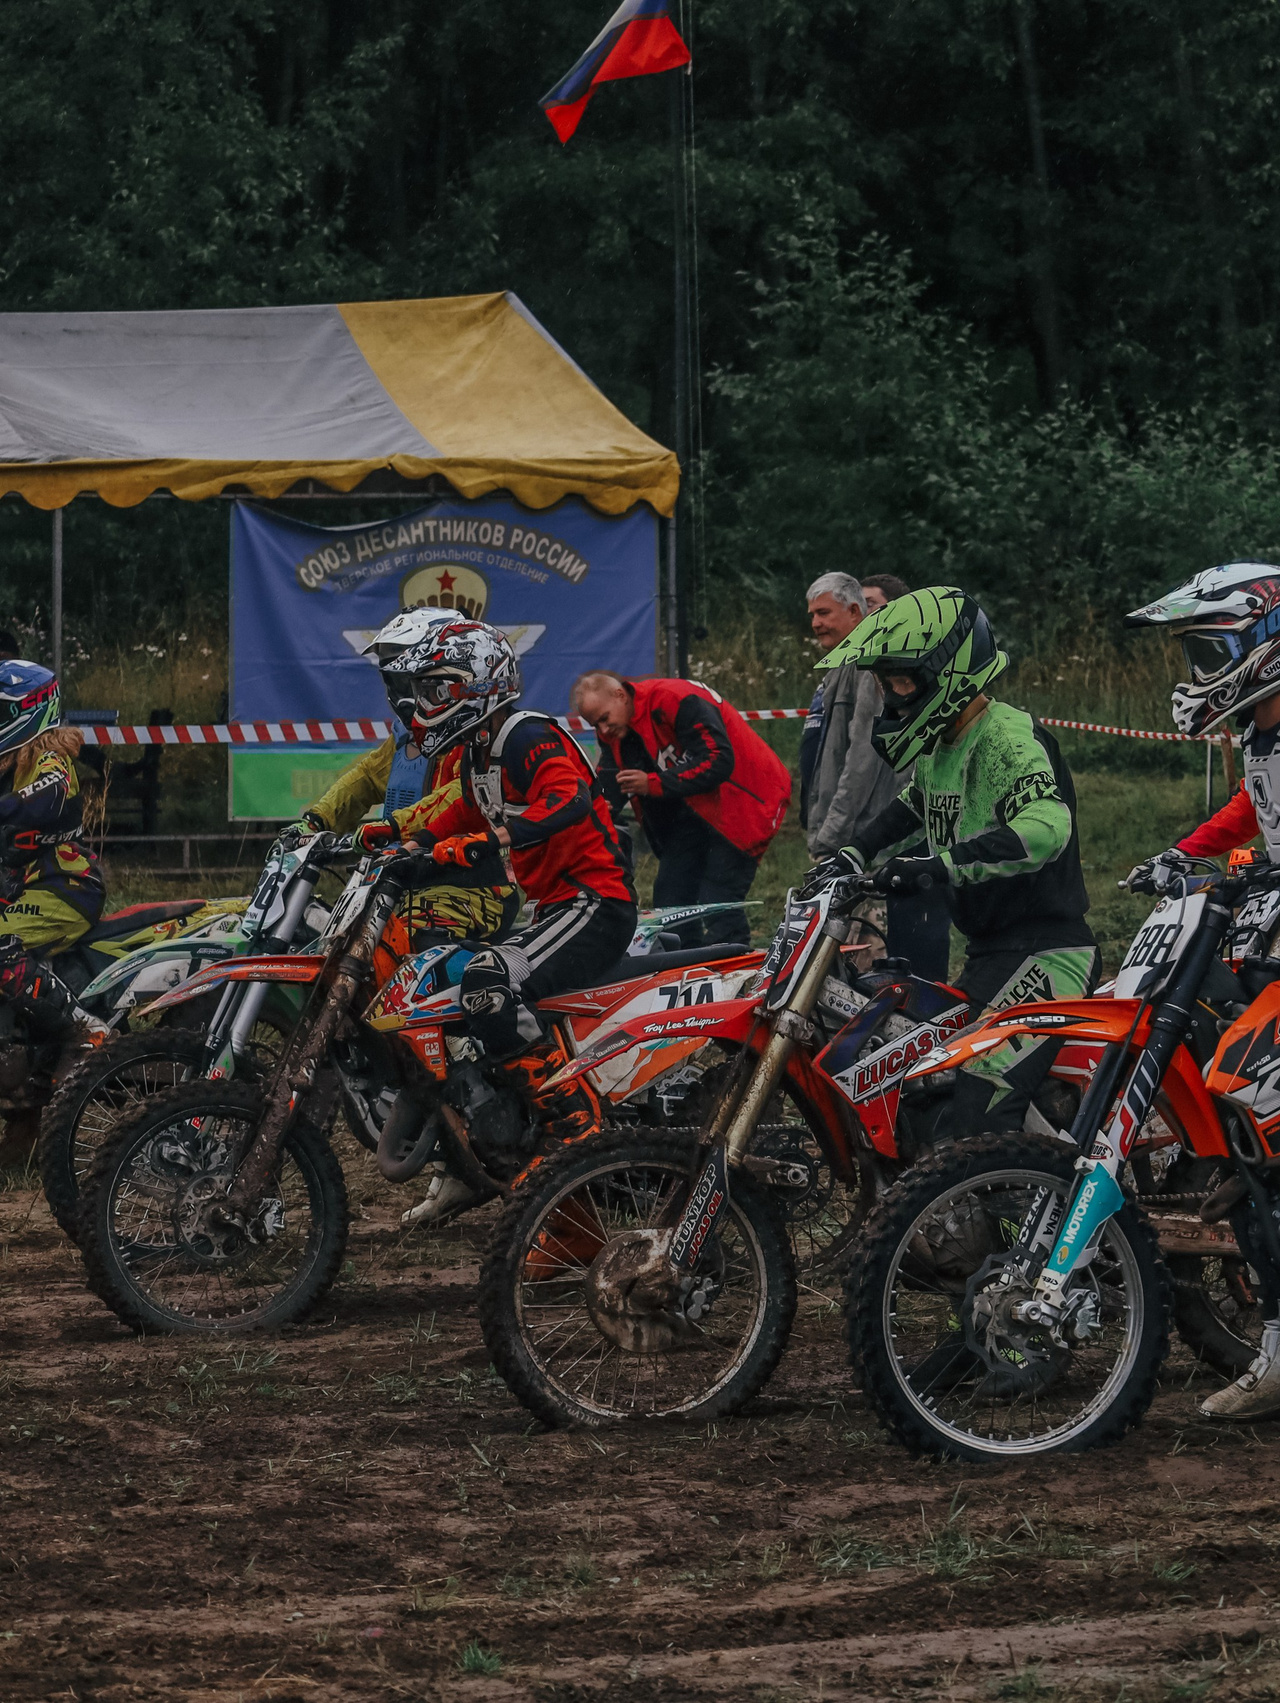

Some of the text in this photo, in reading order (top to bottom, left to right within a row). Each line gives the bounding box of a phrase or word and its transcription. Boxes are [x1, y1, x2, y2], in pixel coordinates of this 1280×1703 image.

[300, 520, 588, 589] СОЮЗ ДЕСАНТНИКОВ РОССИИ
[394, 549, 484, 567] РЕГИОНАЛЬНОЕ
[486, 554, 550, 584] ОТДЕЛЕНИЕ
[595, 986, 626, 998] seaspan
[643, 1016, 725, 1034] Troy Lee Designs
[855, 1031, 935, 1096] LUCAS
[688, 1189, 724, 1267] LUCAS OIL
[1063, 1179, 1099, 1244] MOTOREX
